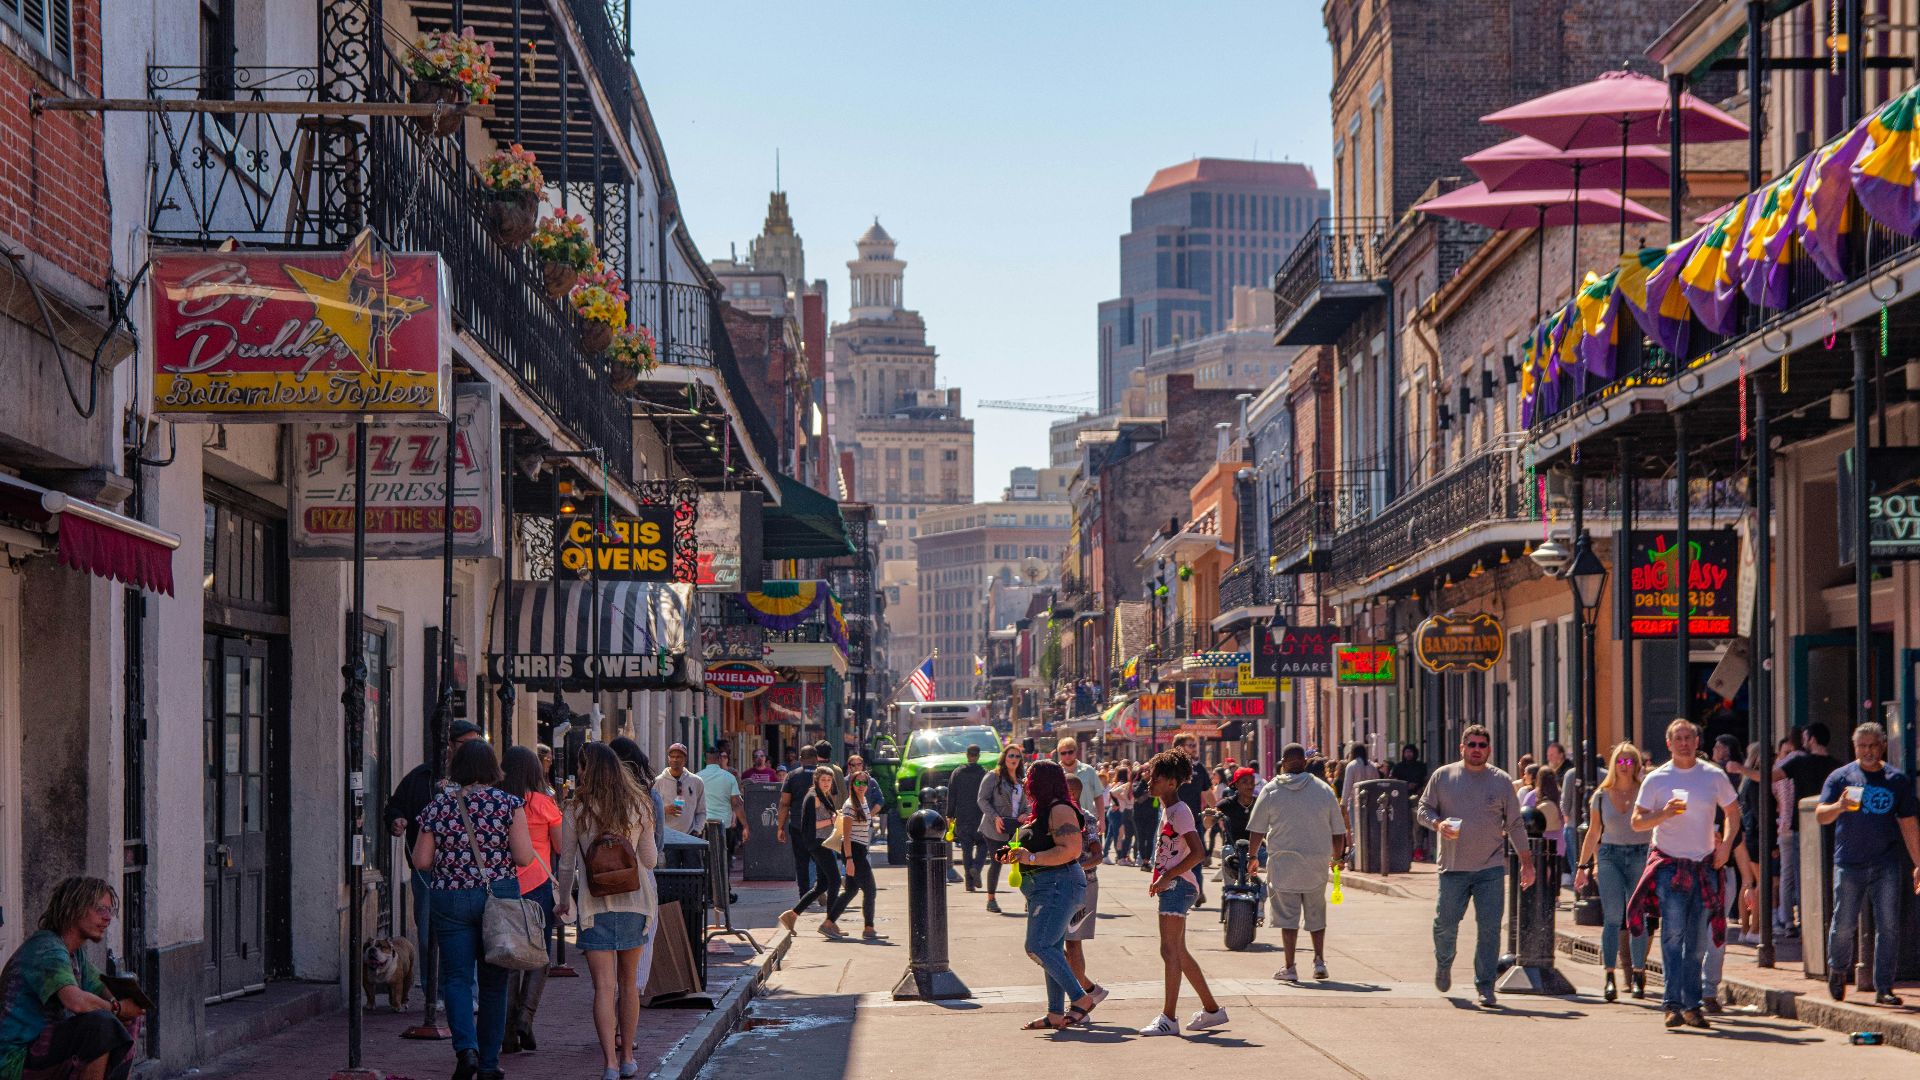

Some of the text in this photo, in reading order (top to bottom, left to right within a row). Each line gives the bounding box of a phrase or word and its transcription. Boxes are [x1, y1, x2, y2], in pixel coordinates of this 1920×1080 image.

[163, 317, 350, 382] Daddy's
[164, 374, 435, 409] Bottomless Topless
[391, 510, 423, 530] THE
[428, 510, 475, 529] SLCE
[561, 547, 667, 572] OWENS
[1631, 559, 1728, 590] BIG ASY
[1263, 644, 1333, 655] SUTR
[1424, 634, 1499, 653] BANDSTAND
[496, 655, 573, 679] CHRIS
[583, 655, 675, 679] OWENS
[704, 671, 775, 685] DIXIELAND
[1245, 699, 1265, 715] CLUB
